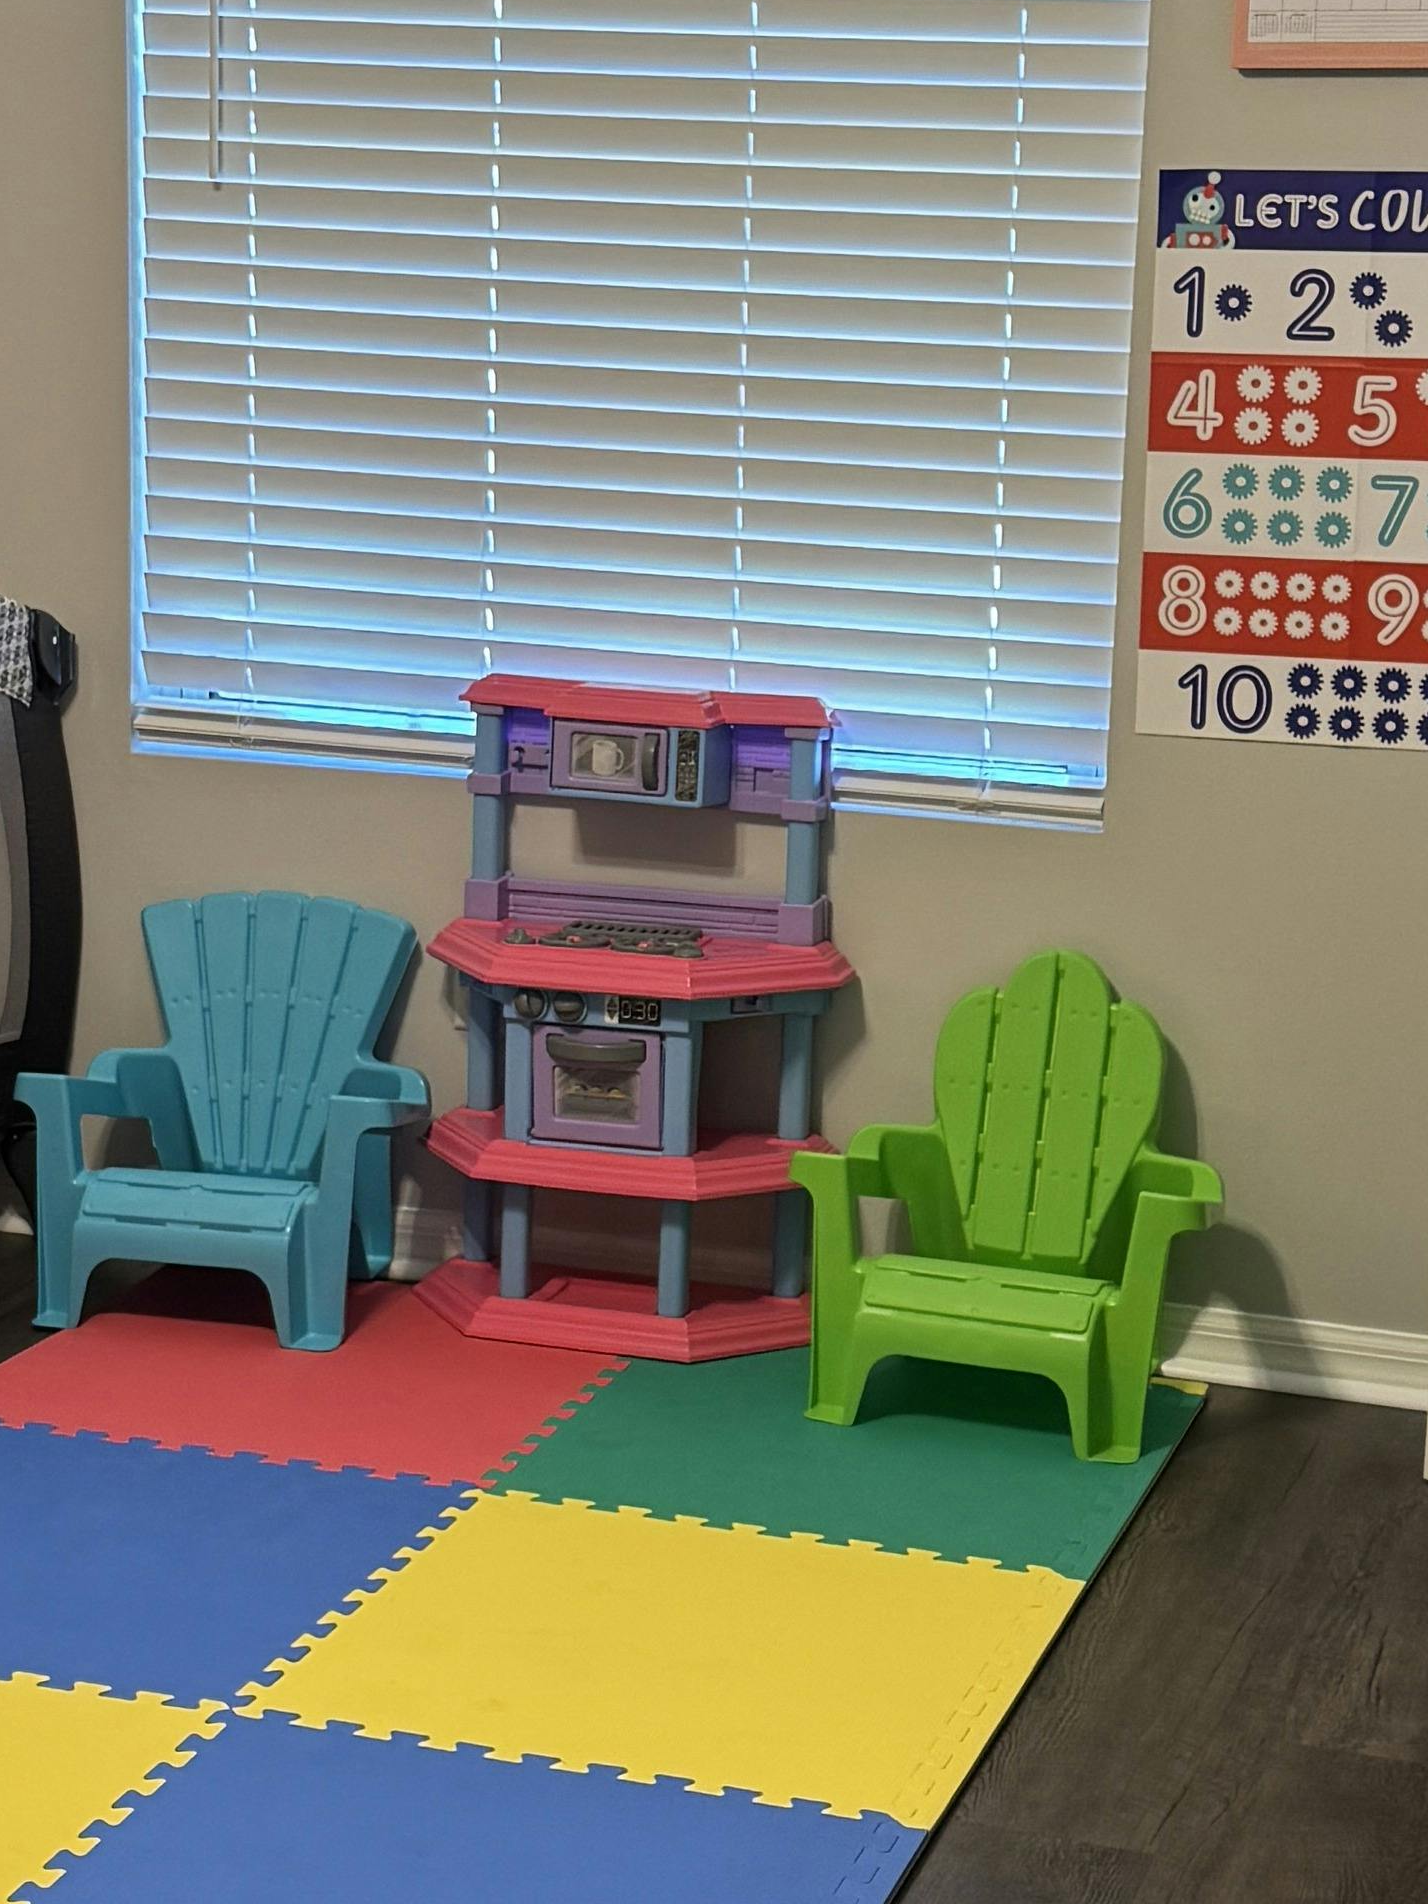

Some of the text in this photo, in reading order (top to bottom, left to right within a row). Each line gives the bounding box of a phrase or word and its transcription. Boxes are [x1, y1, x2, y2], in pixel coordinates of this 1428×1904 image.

[1234, 193, 1339, 229] LET'S
[1173, 265, 1205, 338] 1
[1286, 268, 1335, 341] 2
[1167, 369, 1397, 447] 4 5
[1163, 468, 1419, 547] 6 7
[1158, 565, 1419, 646] 8 9
[1178, 663, 1272, 734] 10
